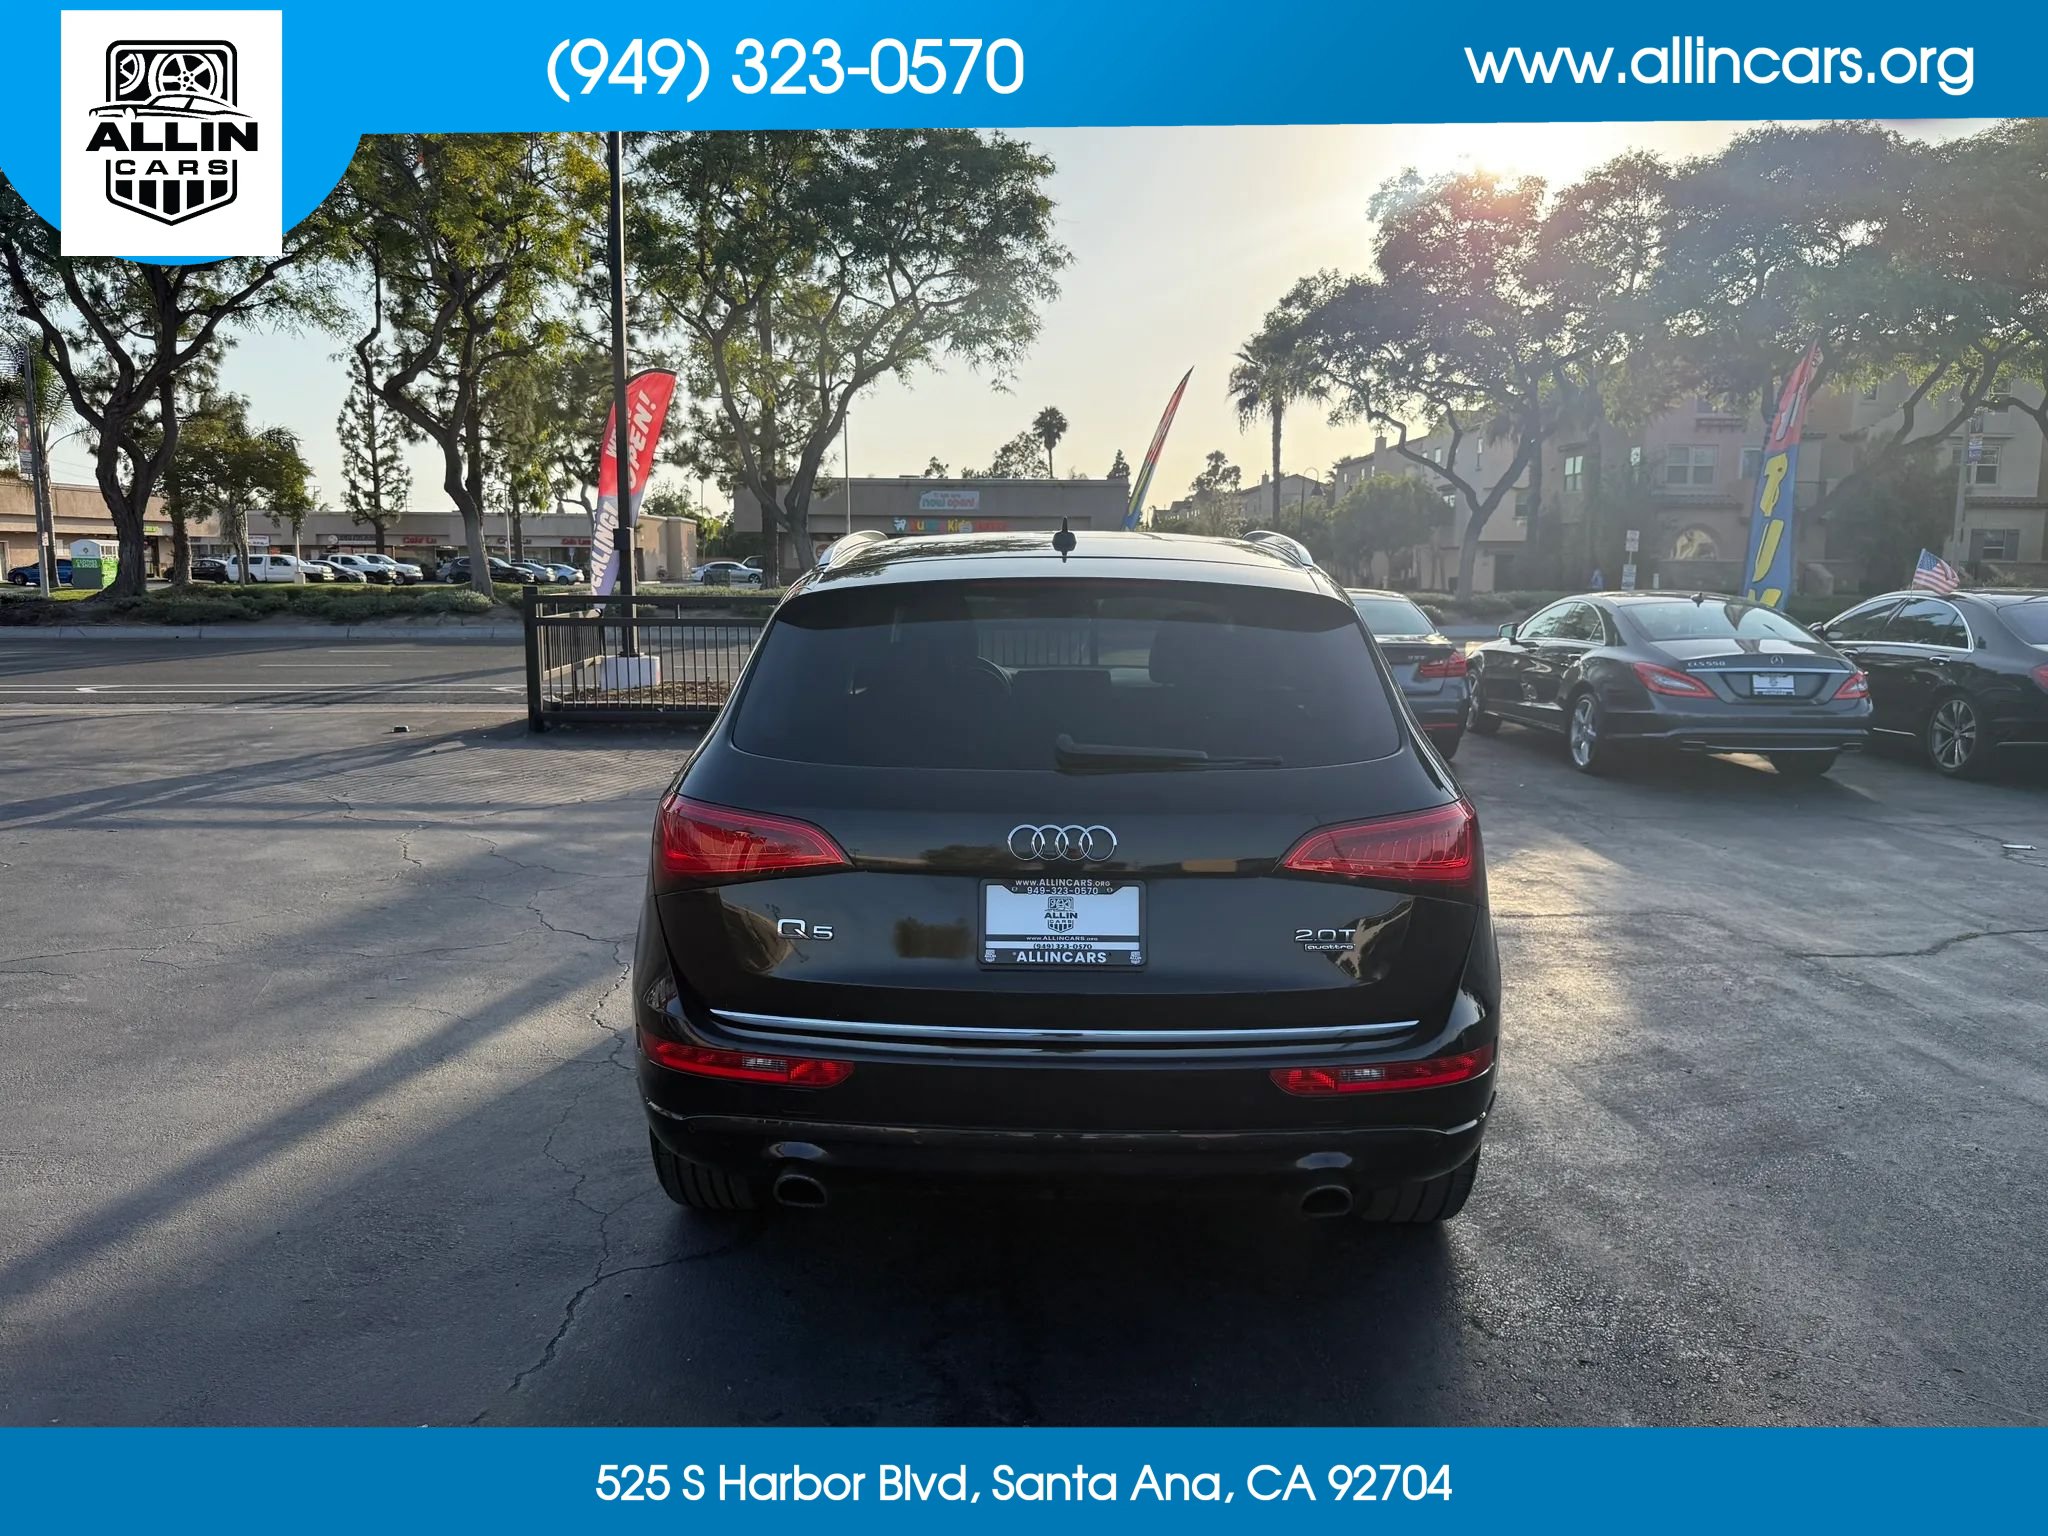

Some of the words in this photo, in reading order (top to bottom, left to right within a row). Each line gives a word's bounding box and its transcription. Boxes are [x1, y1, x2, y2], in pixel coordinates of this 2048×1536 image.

[592, 501, 619, 596] EALING!
[1027, 887, 1099, 895] 949-323-0570
[1295, 929, 1356, 941] 2.0T
[1016, 951, 1107, 964] ALLINCARS
